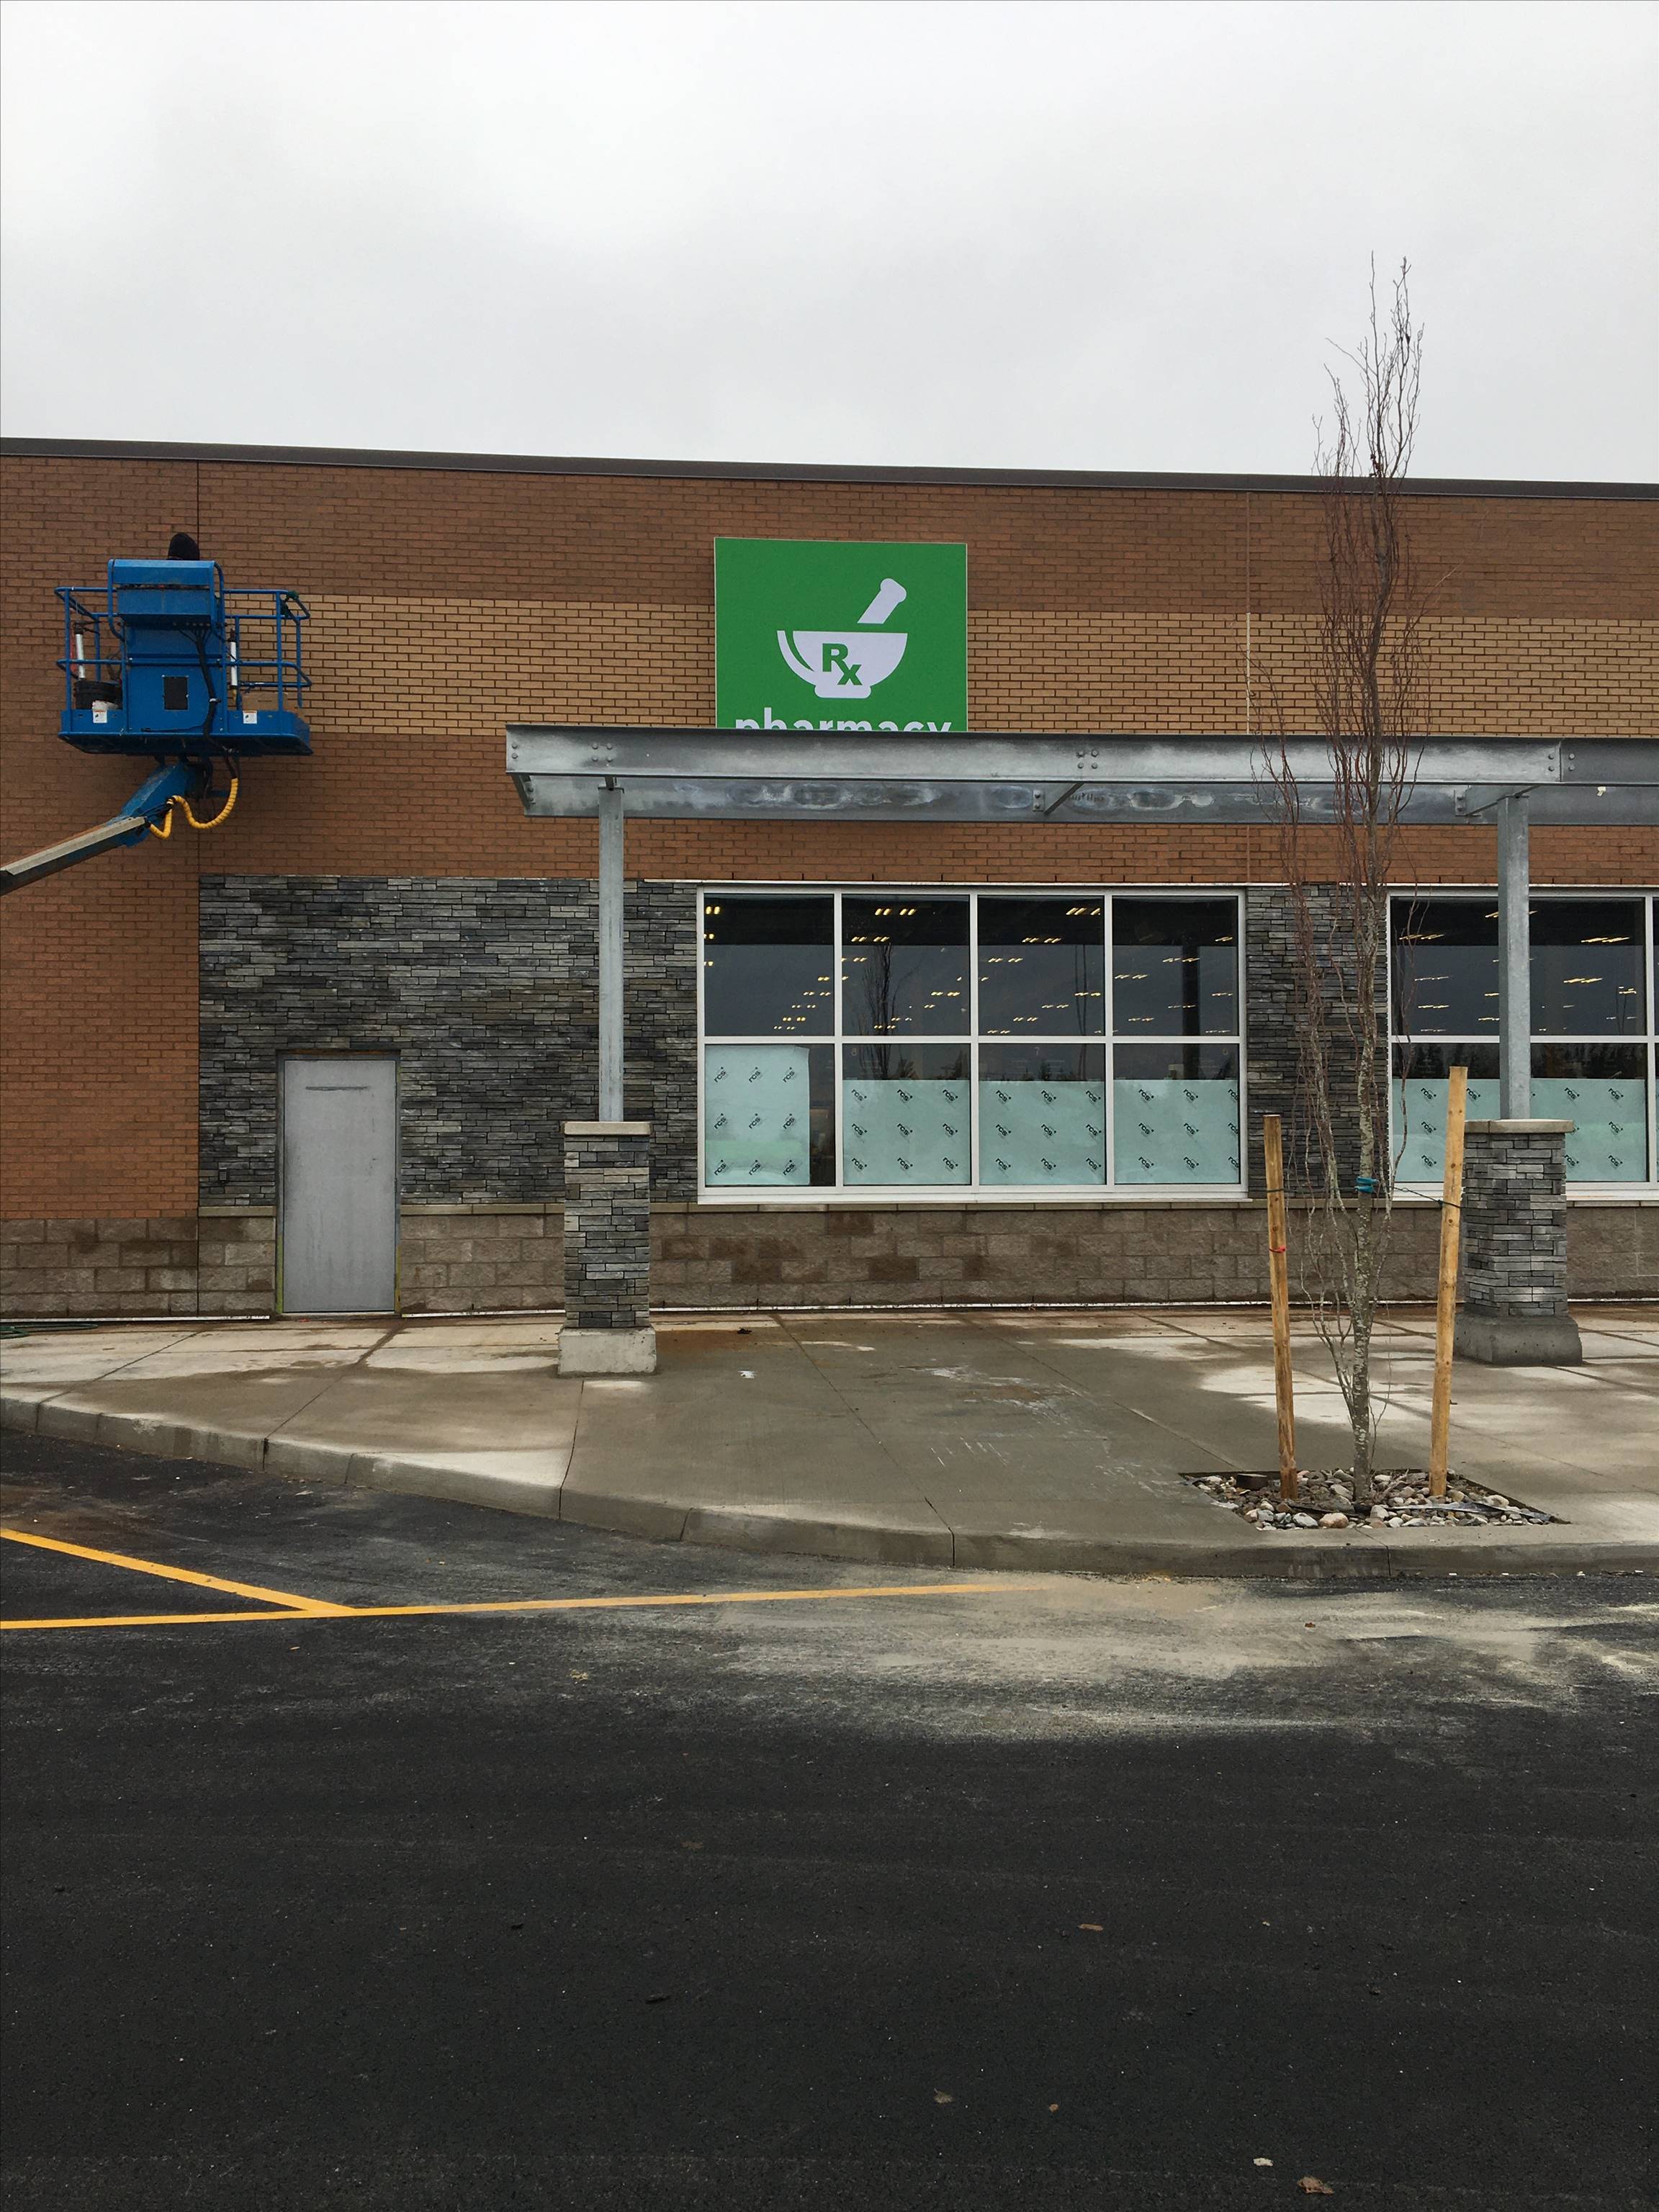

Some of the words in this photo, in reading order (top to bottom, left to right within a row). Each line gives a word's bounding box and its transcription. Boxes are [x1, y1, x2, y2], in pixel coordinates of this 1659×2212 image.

[822, 642, 863, 686] Rx
[714, 1070, 726, 1082] rcs
[749, 1070, 760, 1082] rcs
[783, 1070, 795, 1082] rcs
[851, 1089, 863, 1101] rcs
[897, 1089, 909, 1101] rcs
[943, 1089, 955, 1101] rcs
[996, 1090, 1007, 1102] rcs
[1041, 1090, 1053, 1102] rcs
[1086, 1090, 1097, 1102] rcs
[1138, 1089, 1150, 1101] rcs
[1183, 1089, 1195, 1101] rcs
[1421, 1088, 1433, 1100] rcs
[1564, 1087, 1576, 1100] rcs
[1608, 1088, 1620, 1100] rcs
[714, 1117, 726, 1129] rcs
[749, 1117, 760, 1129] rcs
[783, 1117, 795, 1129] rcs
[1138, 1123, 1150, 1135] rcs
[1183, 1123, 1195, 1135] rcs
[1421, 1122, 1433, 1133] rcs
[1609, 1121, 1620, 1133] rcs
[851, 1123, 863, 1136] rcs
[897, 1123, 909, 1136] rcs
[943, 1123, 955, 1136] rcs
[996, 1124, 1007, 1136] rcs
[1041, 1124, 1053, 1136] rcs
[1086, 1124, 1097, 1136] rcs
[851, 1157, 863, 1169] rcs
[897, 1157, 909, 1169] rcs
[943, 1157, 955, 1169] rcs
[996, 1158, 1007, 1170] rcs
[1041, 1158, 1053, 1170] rcs
[1086, 1158, 1097, 1170] rcs
[1138, 1156, 1150, 1169] rcs
[1183, 1156, 1195, 1169] rcs
[1421, 1155, 1433, 1167] rcs
[1608, 1155, 1619, 1166] rcs
[714, 1163, 726, 1175] rcs
[749, 1163, 760, 1175] rcs
[783, 1163, 795, 1175] rcs
